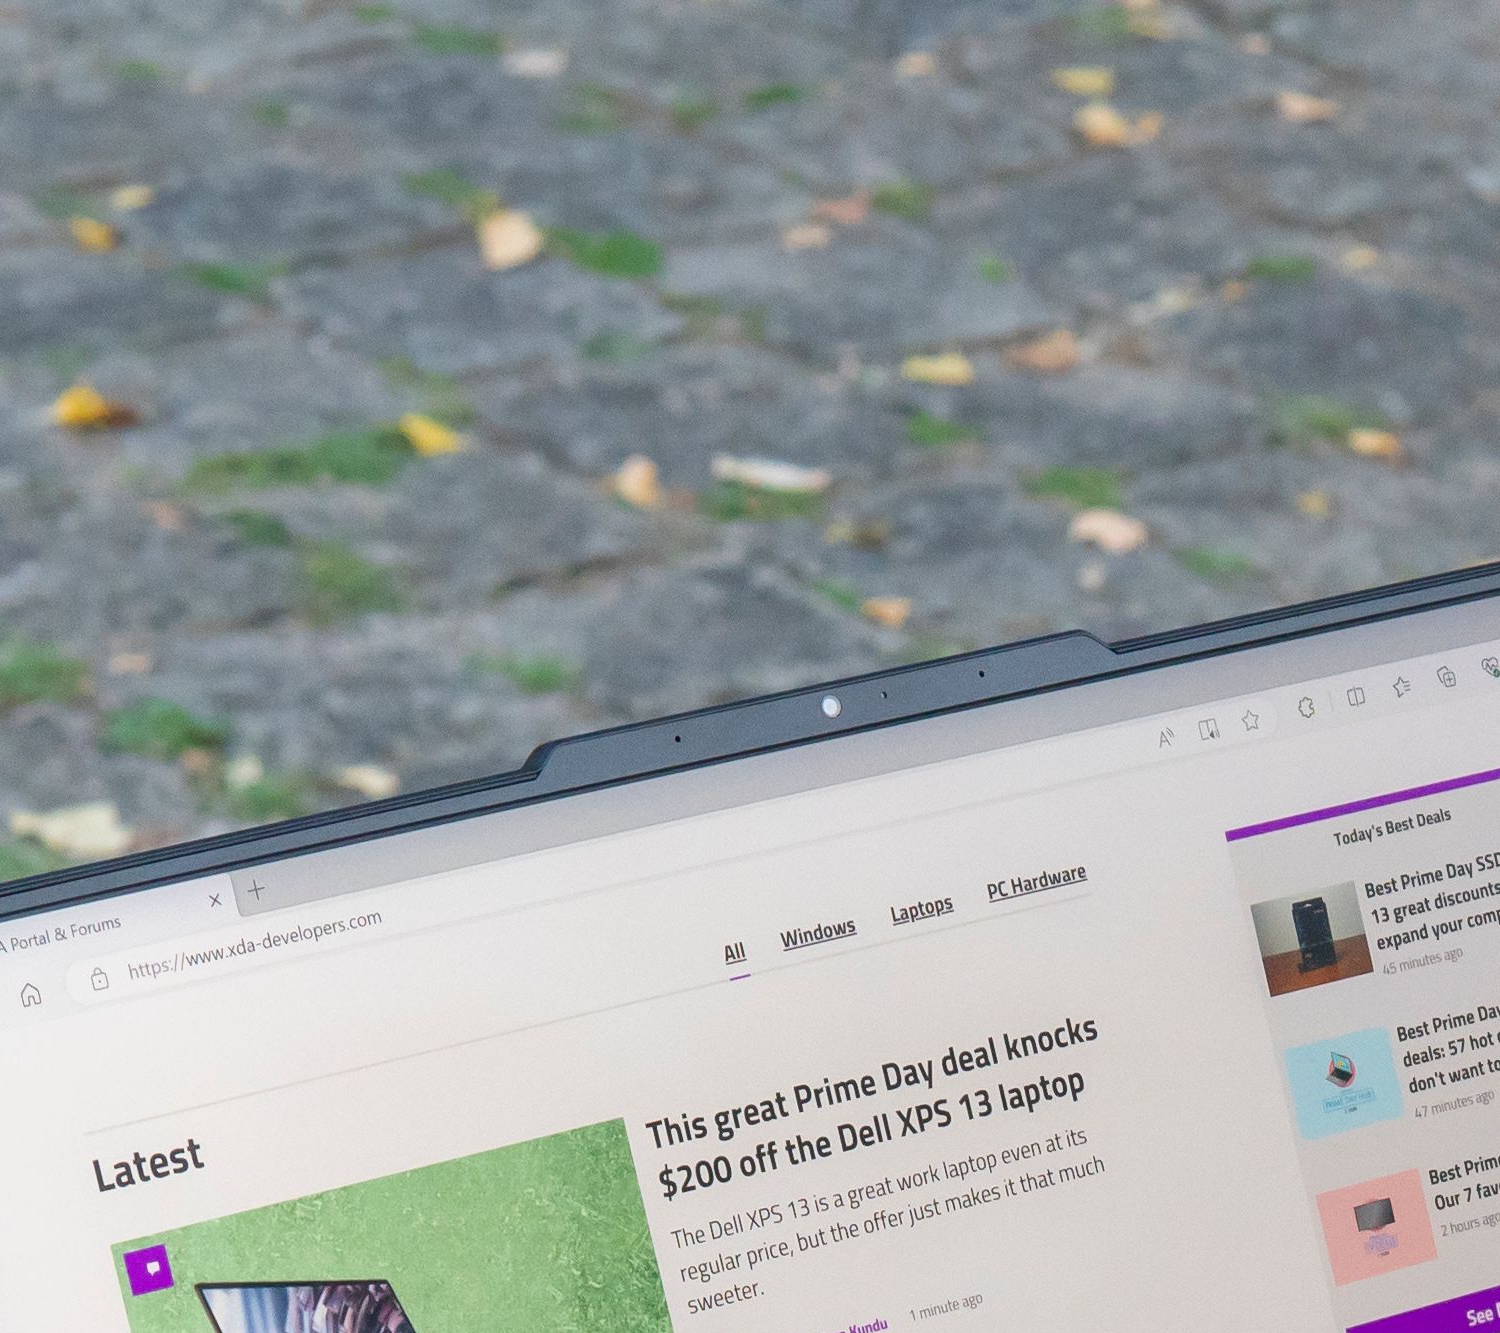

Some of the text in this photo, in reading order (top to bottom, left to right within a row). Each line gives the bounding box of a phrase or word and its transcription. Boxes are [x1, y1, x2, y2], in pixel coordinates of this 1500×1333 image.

[1332, 808, 1452, 846] Today's Best Deals
[986, 866, 1087, 901] PC Hardware
[1364, 877, 1399, 899] Best
[1399, 869, 1444, 890] Prime
[1445, 862, 1473, 879] Day
[890, 897, 954, 924] Laptops
[1371, 906, 1390, 924] 13
[1392, 897, 1432, 924] great
[9, 929, 51, 952] Portal
[54, 926, 68, 942] &
[69, 917, 122, 938] Forums
[127, 911, 383, 979] https://www.xda-developers.com
[779, 919, 856, 950] Windows
[1376, 922, 1429, 951] expand
[1431, 918, 1463, 941] your
[724, 941, 746, 963] All
[1396, 1021, 1430, 1043] Best
[1431, 1012, 1475, 1033] Prime
[1402, 1045, 1446, 1068] deals:
[1447, 1037, 1465, 1057] 57
[1468, 1031, 1495, 1051] hot
[644, 1017, 1098, 1149] This great Prime Day deal knocks
[1408, 1071, 1447, 1094] don't
[1448, 1060, 1485, 1083] want
[658, 1072, 1085, 1202] $200 off the Dell XPS 13 laptop
[92, 1138, 205, 1192] Latest
[1428, 1163, 1462, 1186] Best
[1434, 1193, 1460, 1211] Our
[1462, 1186, 1472, 1203] 7
[1465, 1307, 1494, 1327] See
